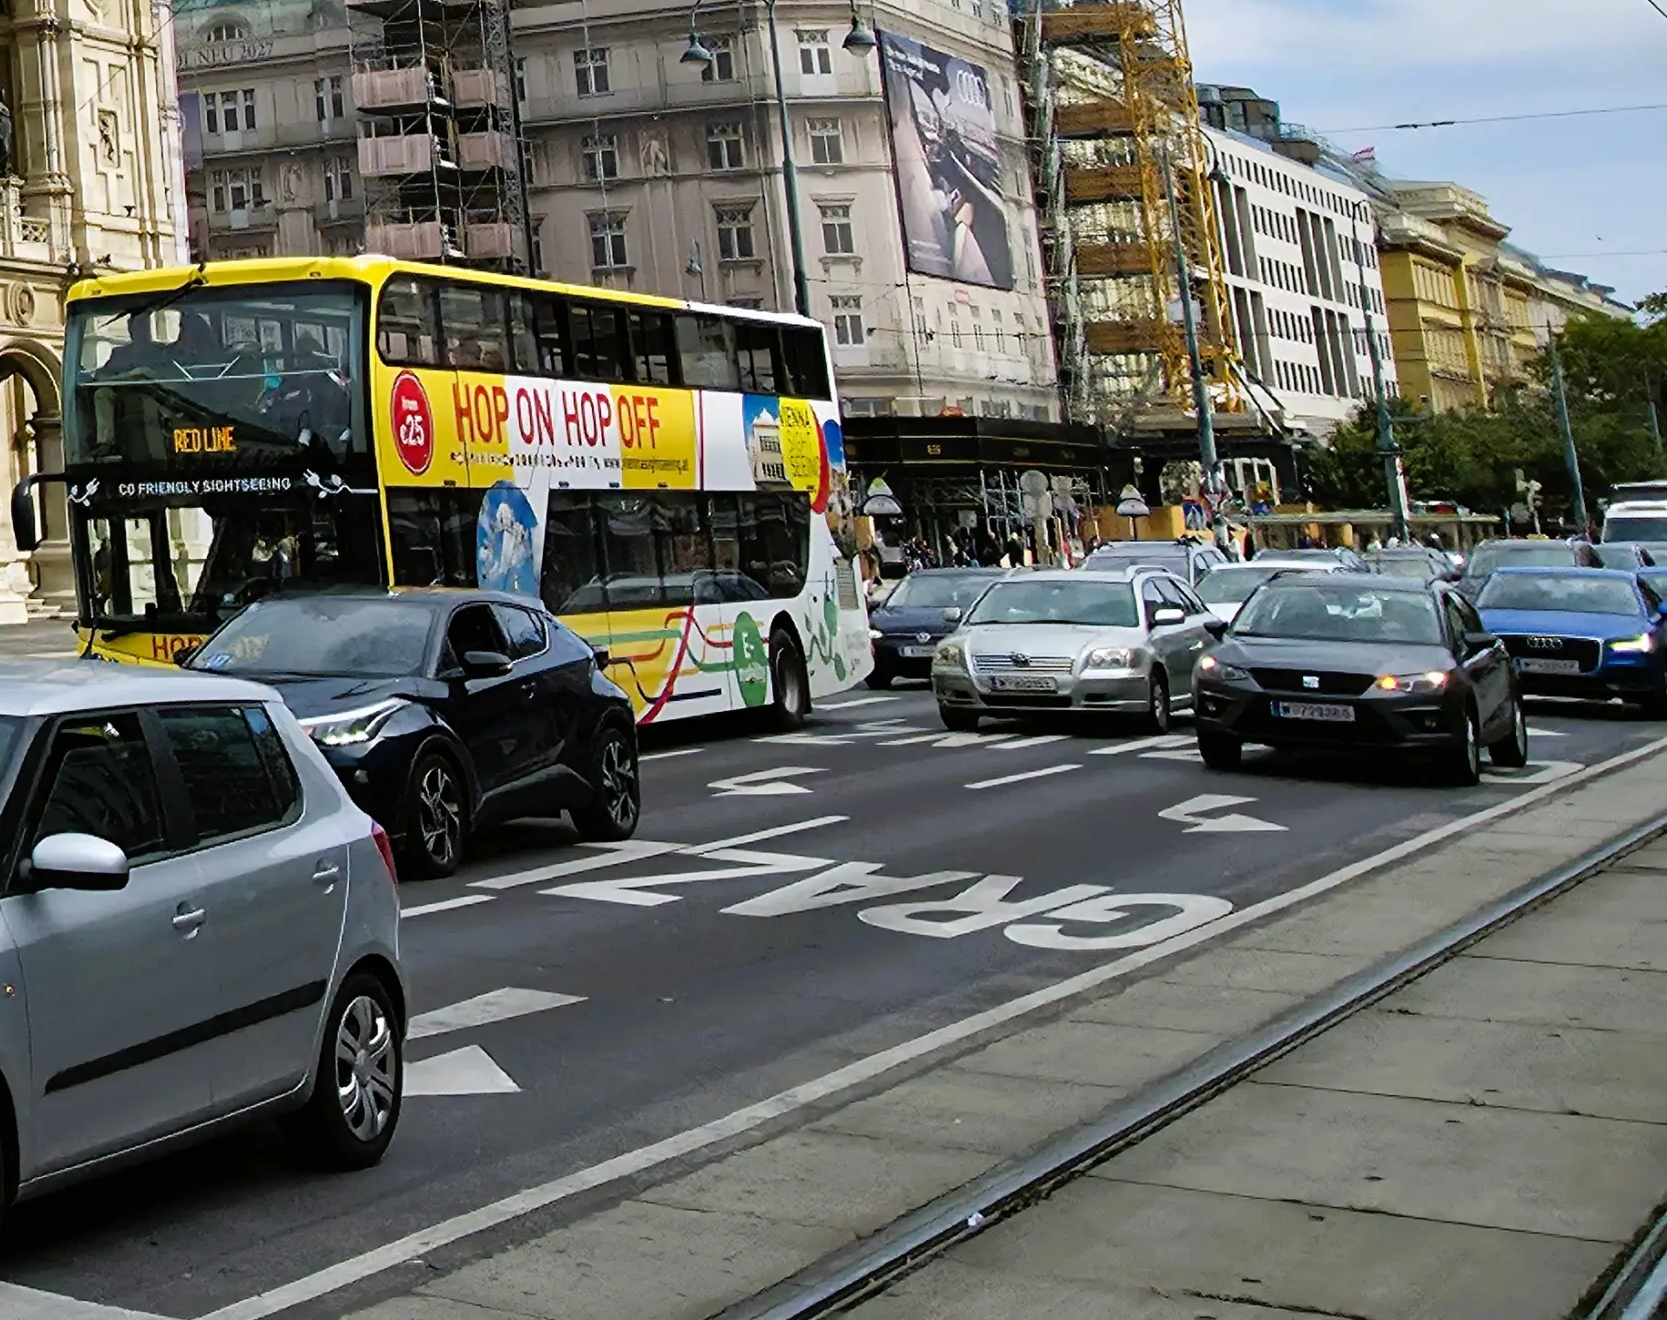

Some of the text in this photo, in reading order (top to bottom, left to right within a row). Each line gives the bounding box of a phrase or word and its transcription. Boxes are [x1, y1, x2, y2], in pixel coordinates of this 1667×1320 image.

[173, 426, 238, 453] RED LINE
[452, 382, 661, 450] HOP ON HOP OFF
[137, 480, 200, 496] FRIENDLY
[202, 477, 292, 494] SIGHTSEEING
[537, 848, 1234, 950] GRAZ
